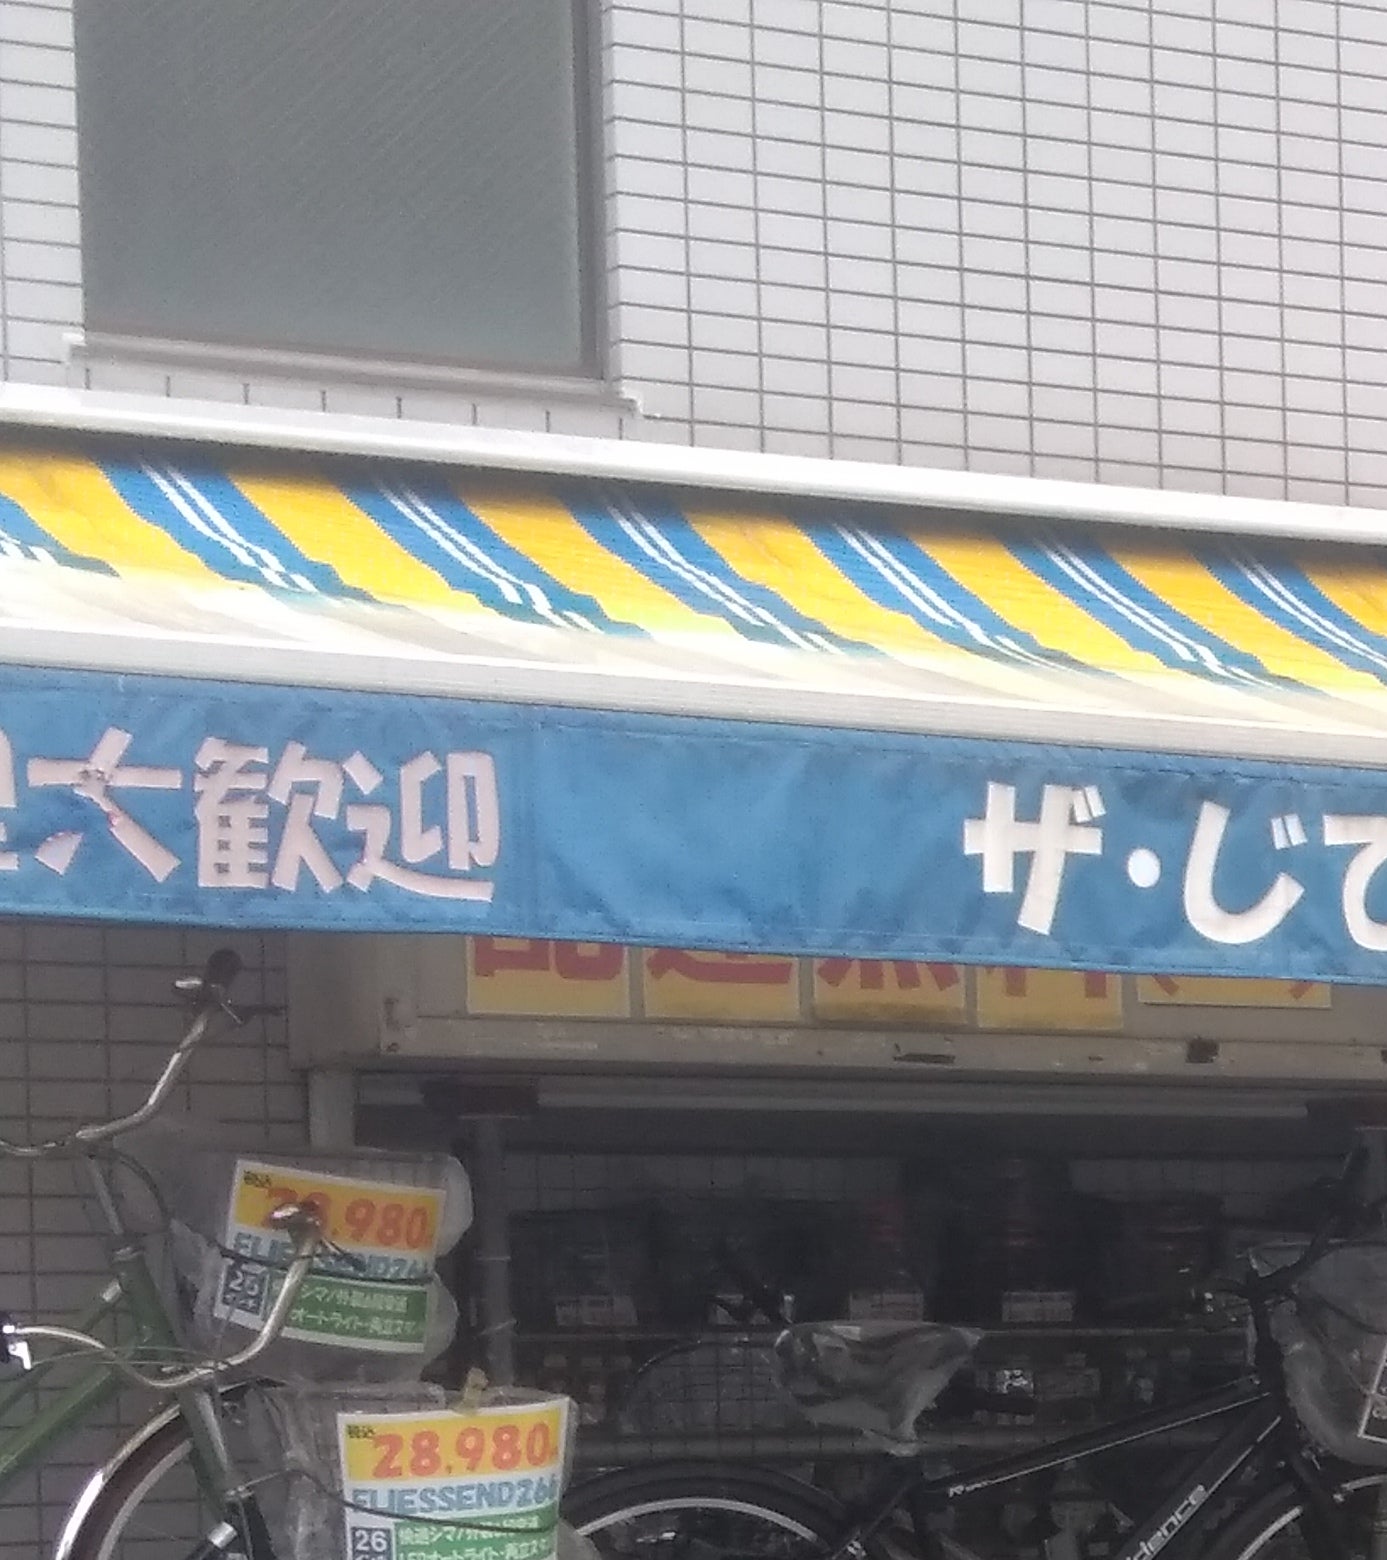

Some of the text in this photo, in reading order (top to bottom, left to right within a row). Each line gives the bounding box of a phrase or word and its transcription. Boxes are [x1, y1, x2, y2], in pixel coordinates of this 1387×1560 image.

[0, 726, 500, 902] 大歓迎
[354, 1530, 388, 1552] 26
